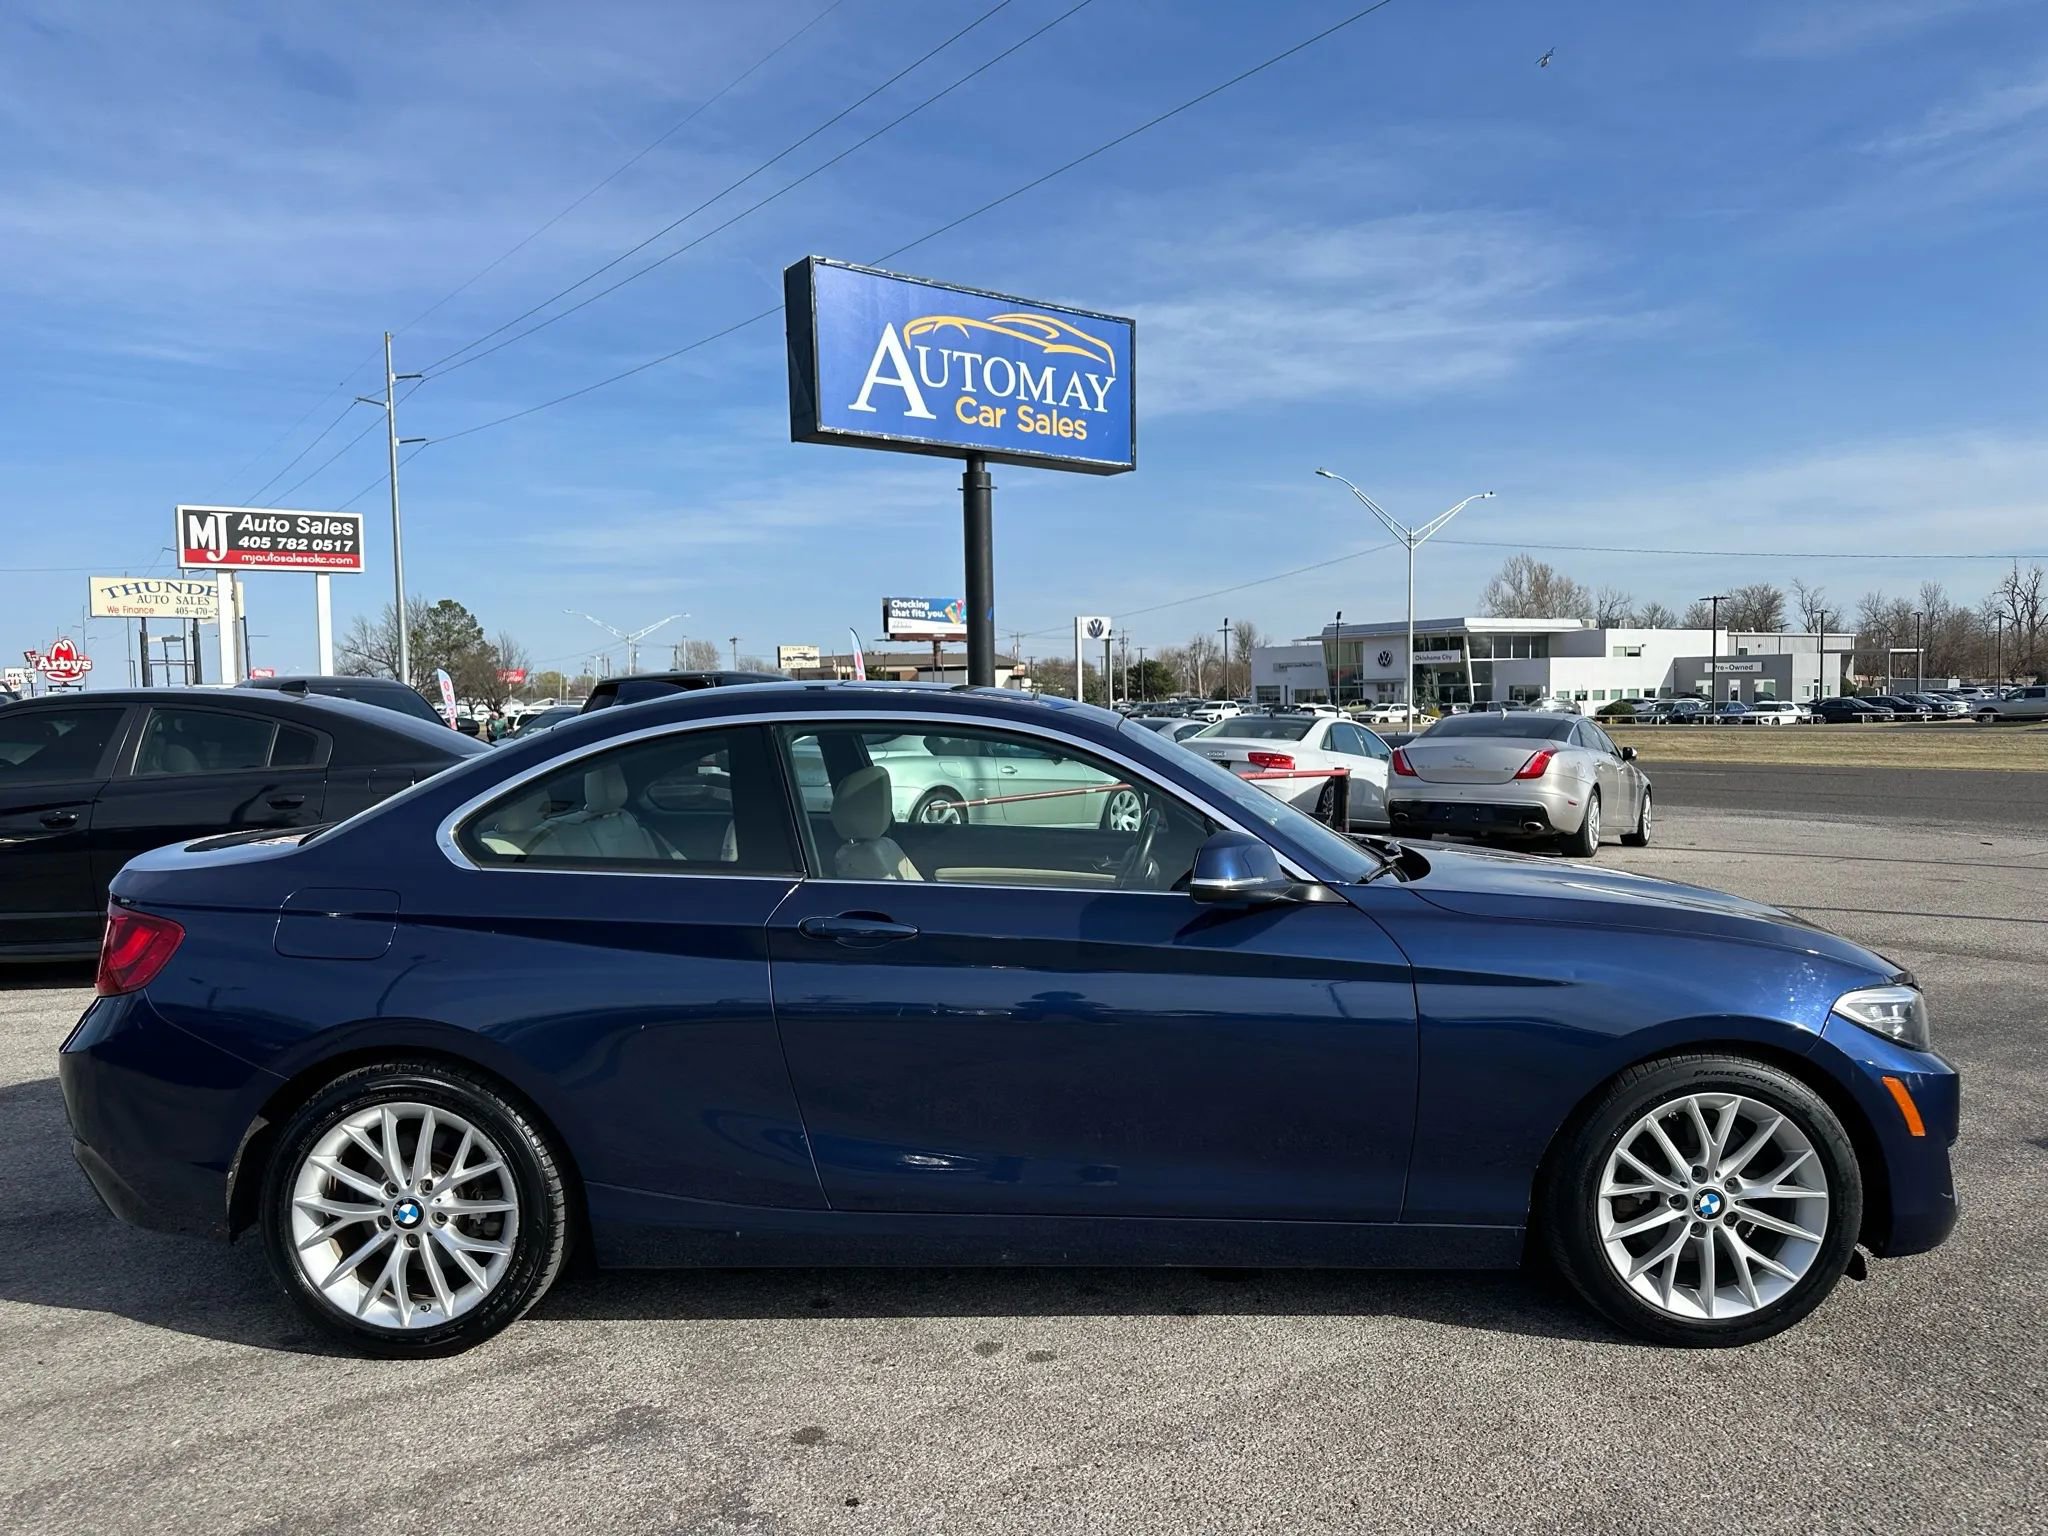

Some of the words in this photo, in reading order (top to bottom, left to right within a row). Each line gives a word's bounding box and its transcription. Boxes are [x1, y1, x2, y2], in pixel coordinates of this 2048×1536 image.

[955, 396, 1007, 429] Car
[1017, 405, 1088, 441] Sales
[237, 514, 290, 533] Auto
[296, 517, 354, 536] Sales
[188, 512, 233, 562] MJ
[238, 536, 271, 549] 405
[277, 538, 308, 550] 782
[312, 540, 354, 552] 0517
[241, 552, 353, 565] mjautosalesokc.com
[137, 595, 169, 604] AUTO
[176, 595, 210, 606] SALES
[891, 600, 929, 610] Checking
[106, 605, 119, 614] We
[122, 605, 155, 615] Finance
[891, 609, 910, 617] that
[911, 610, 926, 618] fits
[927, 611, 945, 619] you.
[37, 655, 92, 673] Arby's
